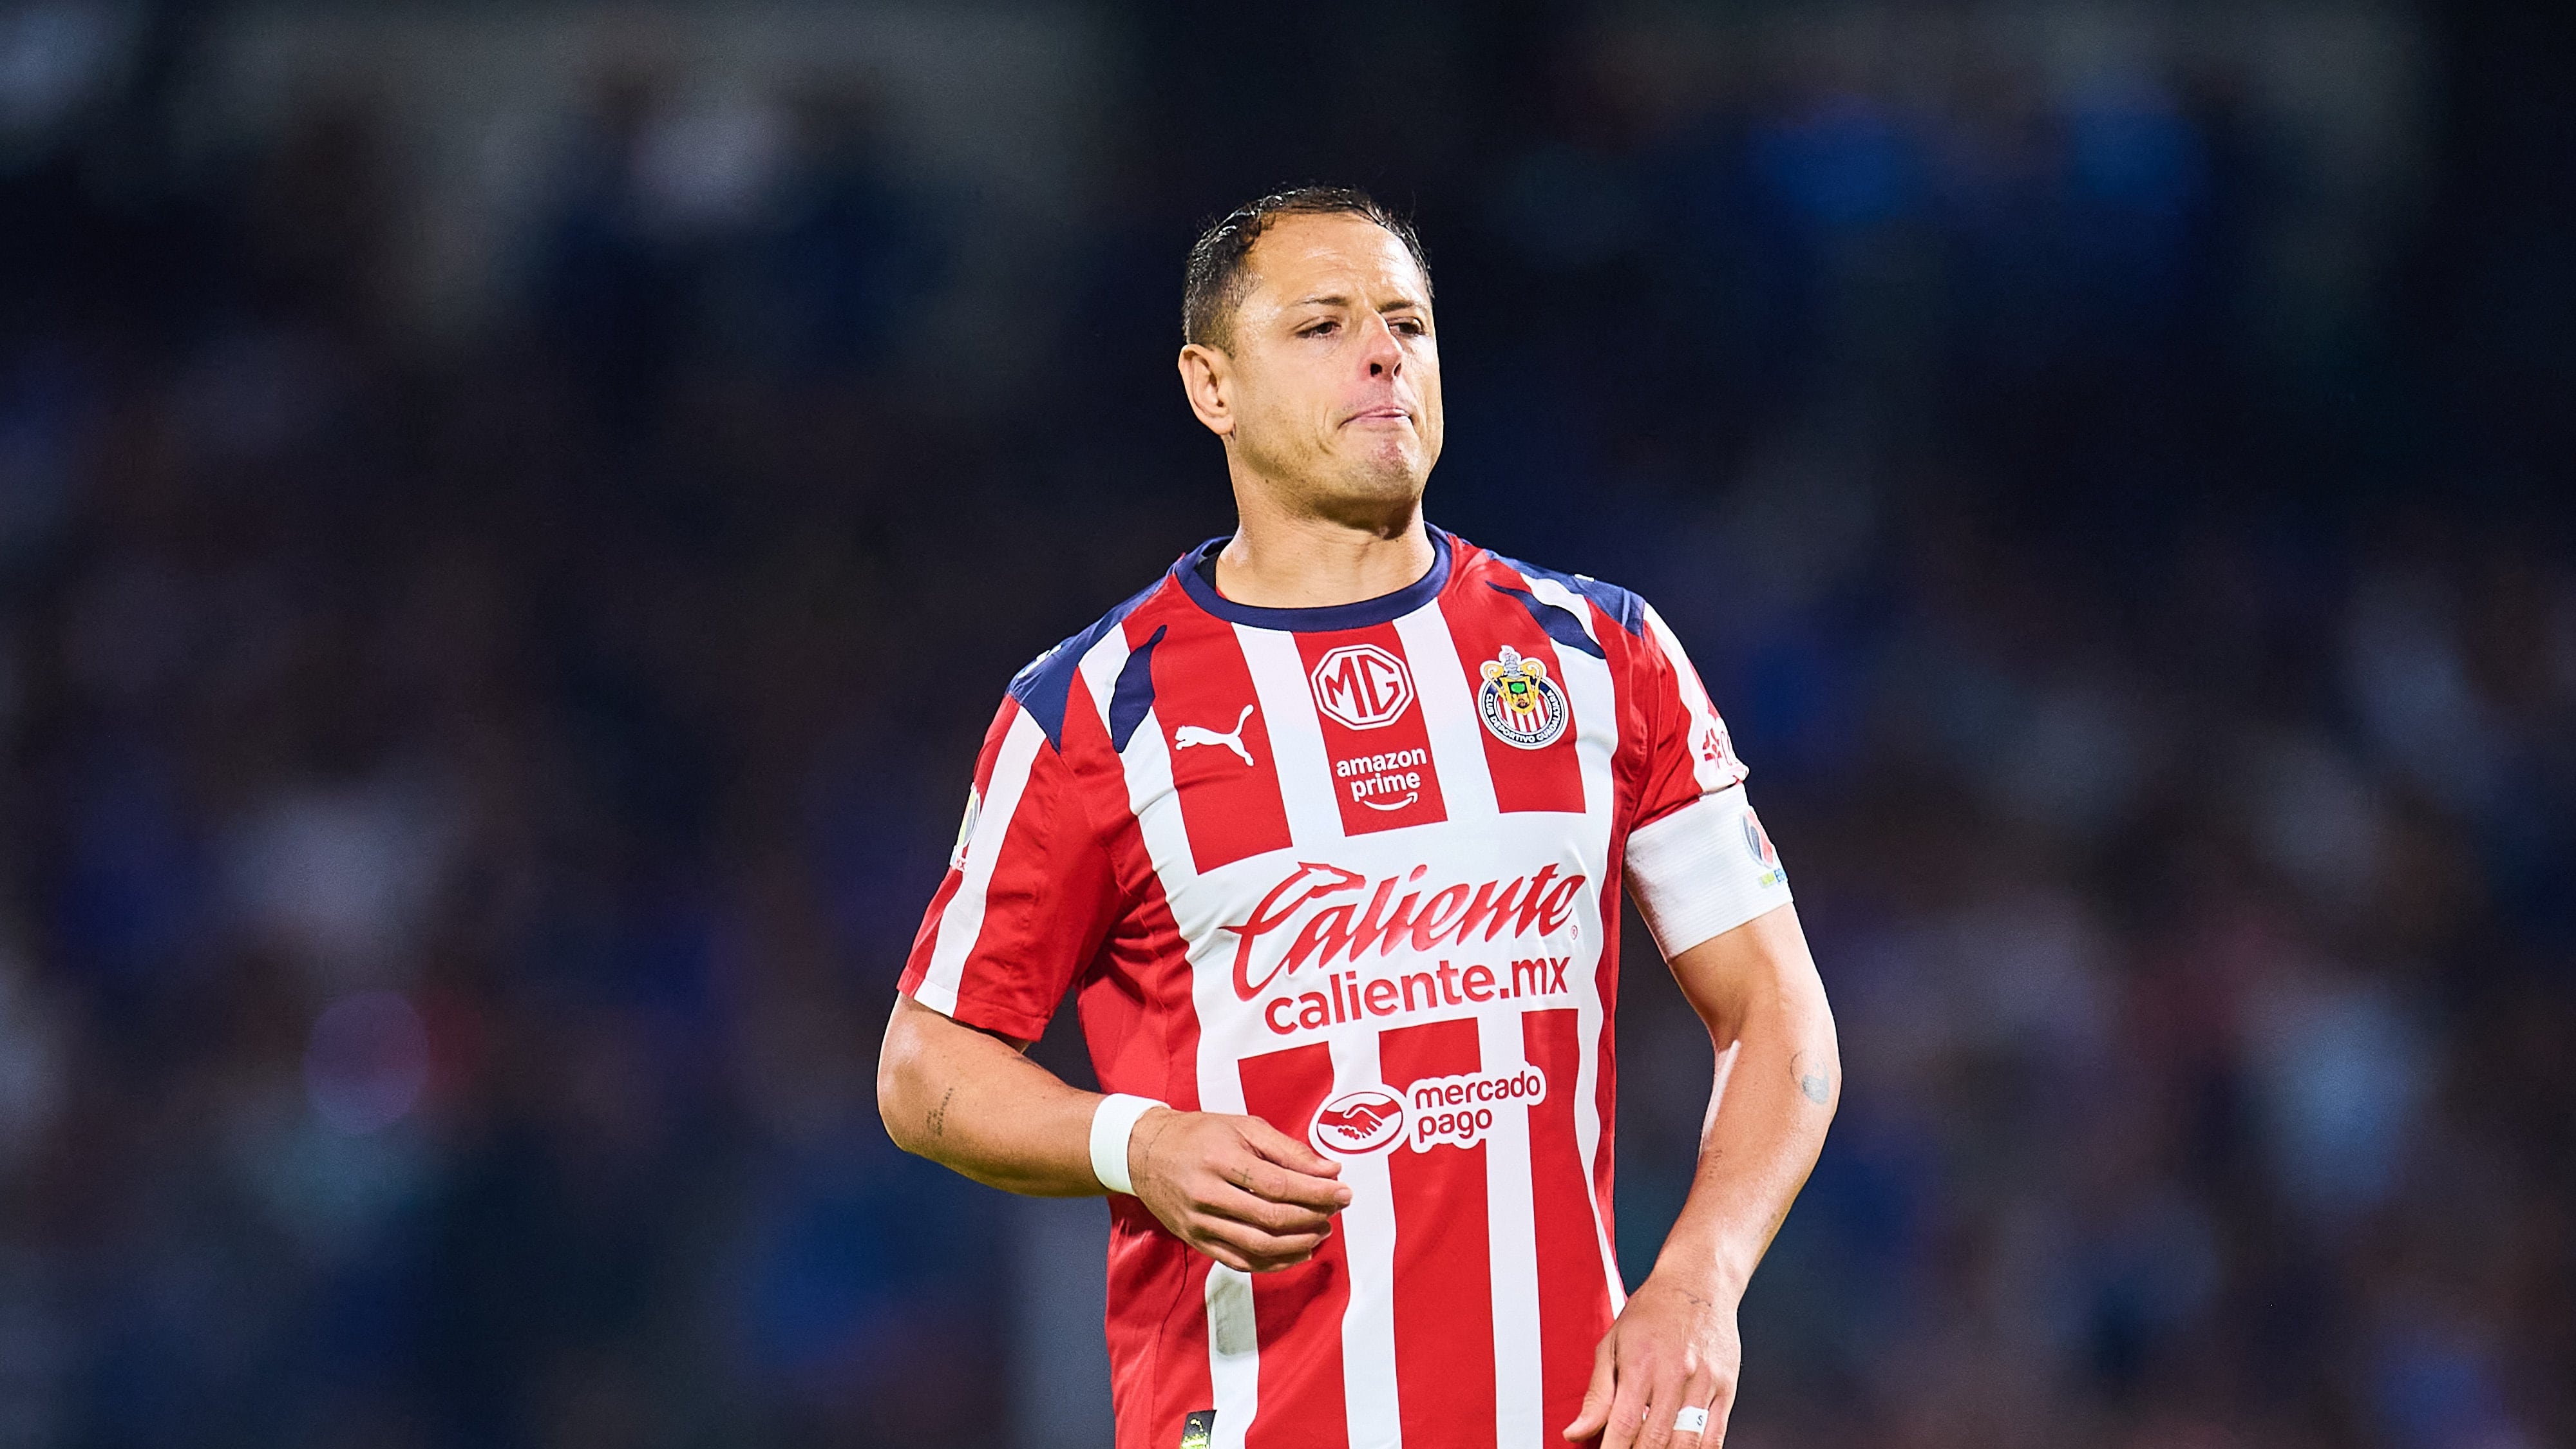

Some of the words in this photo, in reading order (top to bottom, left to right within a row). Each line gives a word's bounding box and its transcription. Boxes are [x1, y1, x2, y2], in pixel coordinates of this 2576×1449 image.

[1324, 655, 1399, 717] MG
[1486, 693, 1494, 715] CLUB
[1491, 717, 1535, 743] DEPORTIVO
[1536, 690, 1561, 741] GUADALAJARA
[1336, 748, 1427, 777] amazon
[1350, 771, 1421, 802] prime
[1218, 862, 1586, 1002] Caliente
[1265, 956, 1570, 1035] caliente.mx
[1416, 1070, 1540, 1110] mercado
[1418, 1109, 1493, 1144] pago
